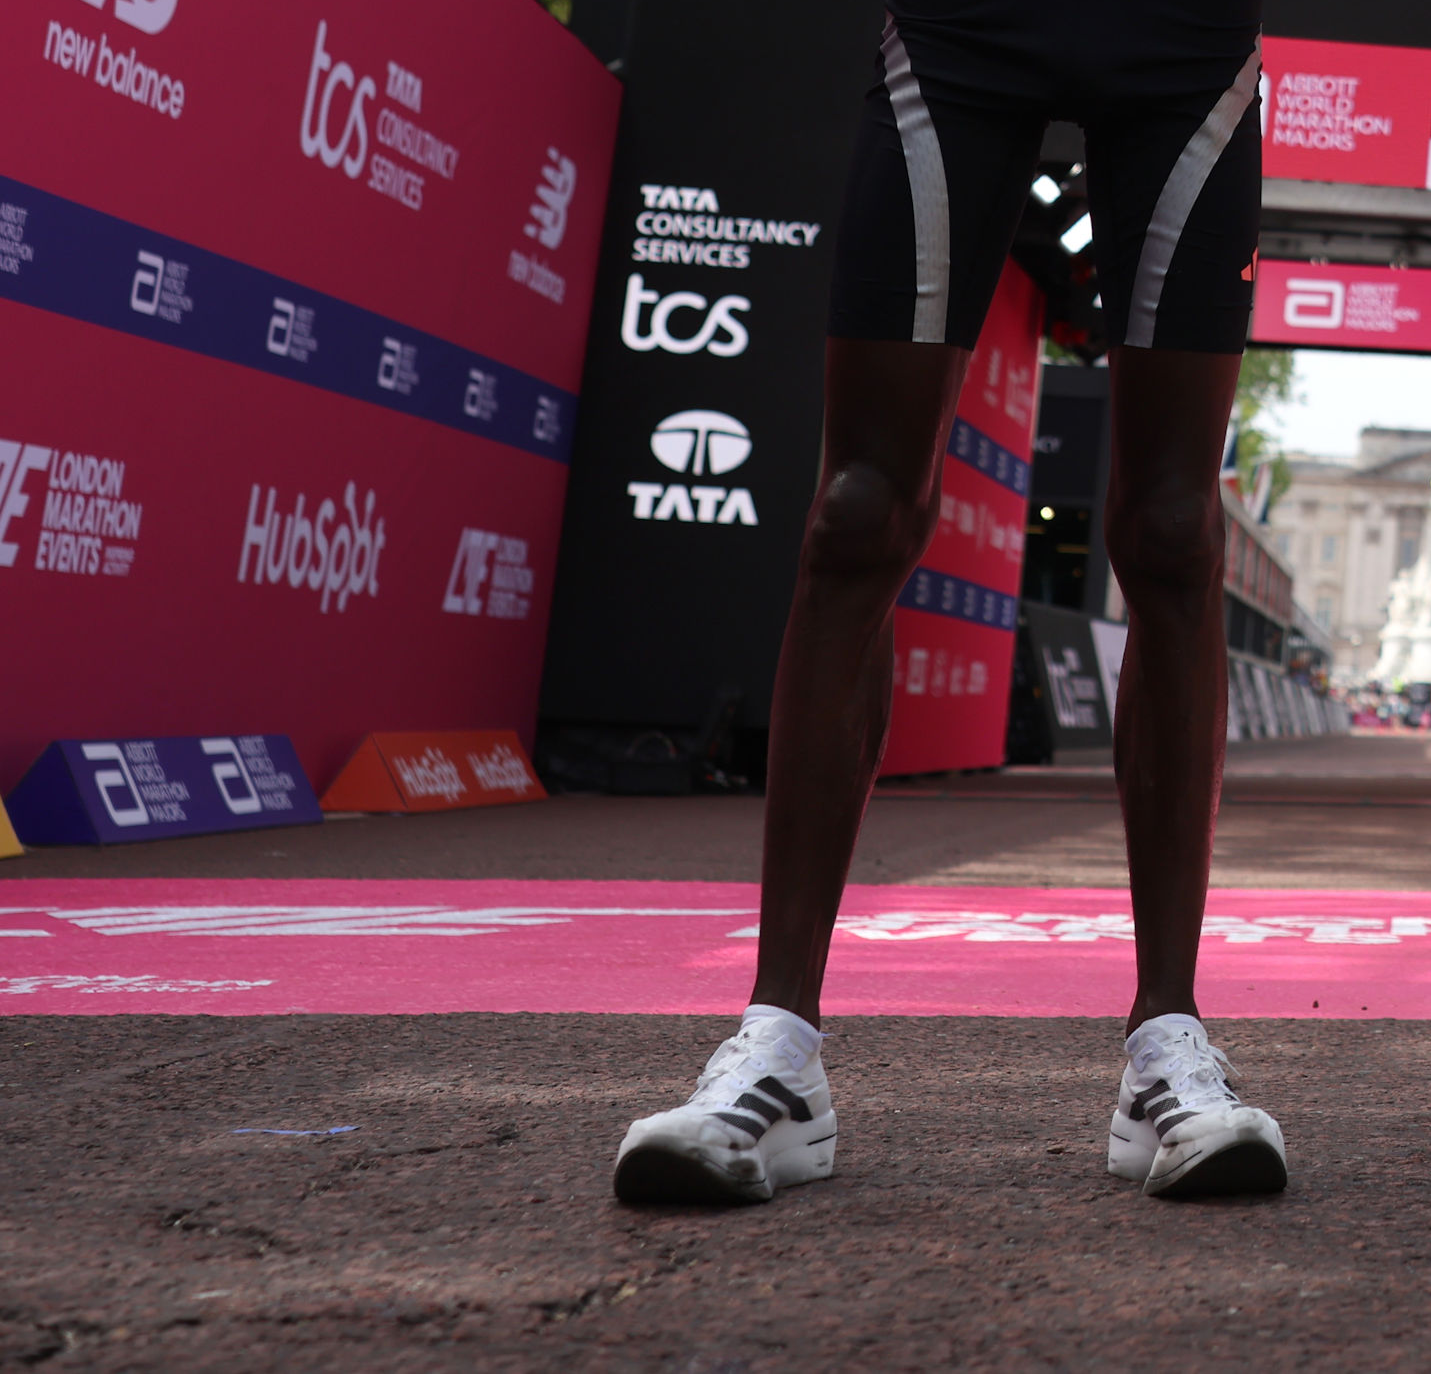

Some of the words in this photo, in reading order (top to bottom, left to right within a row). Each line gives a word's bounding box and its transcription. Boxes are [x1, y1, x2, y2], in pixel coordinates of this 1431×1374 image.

[44, 20, 95, 83] new
[96, 36, 185, 120] balance
[1277, 73, 1359, 96] ABBOTT
[300, 19, 376, 179] tcs
[387, 61, 423, 112] TATA
[1276, 94, 1354, 114] WORLD
[376, 108, 459, 182] CONSULTANCY
[1272, 129, 1355, 151] MAJORS
[1274, 111, 1393, 136] MARATHON
[368, 153, 424, 212] SERVICES
[640, 184, 719, 213] TATA
[636, 211, 821, 247] CONSULTANCY
[632, 237, 750, 269] SERVICES
[621, 272, 751, 357] tcs
[49, 449, 125, 498] LONDON
[42, 490, 143, 541] MARATHON
[627, 483, 758, 526] TATA
[35, 529, 103, 575] EVENTS
[237, 480, 386, 614] HubSpot
